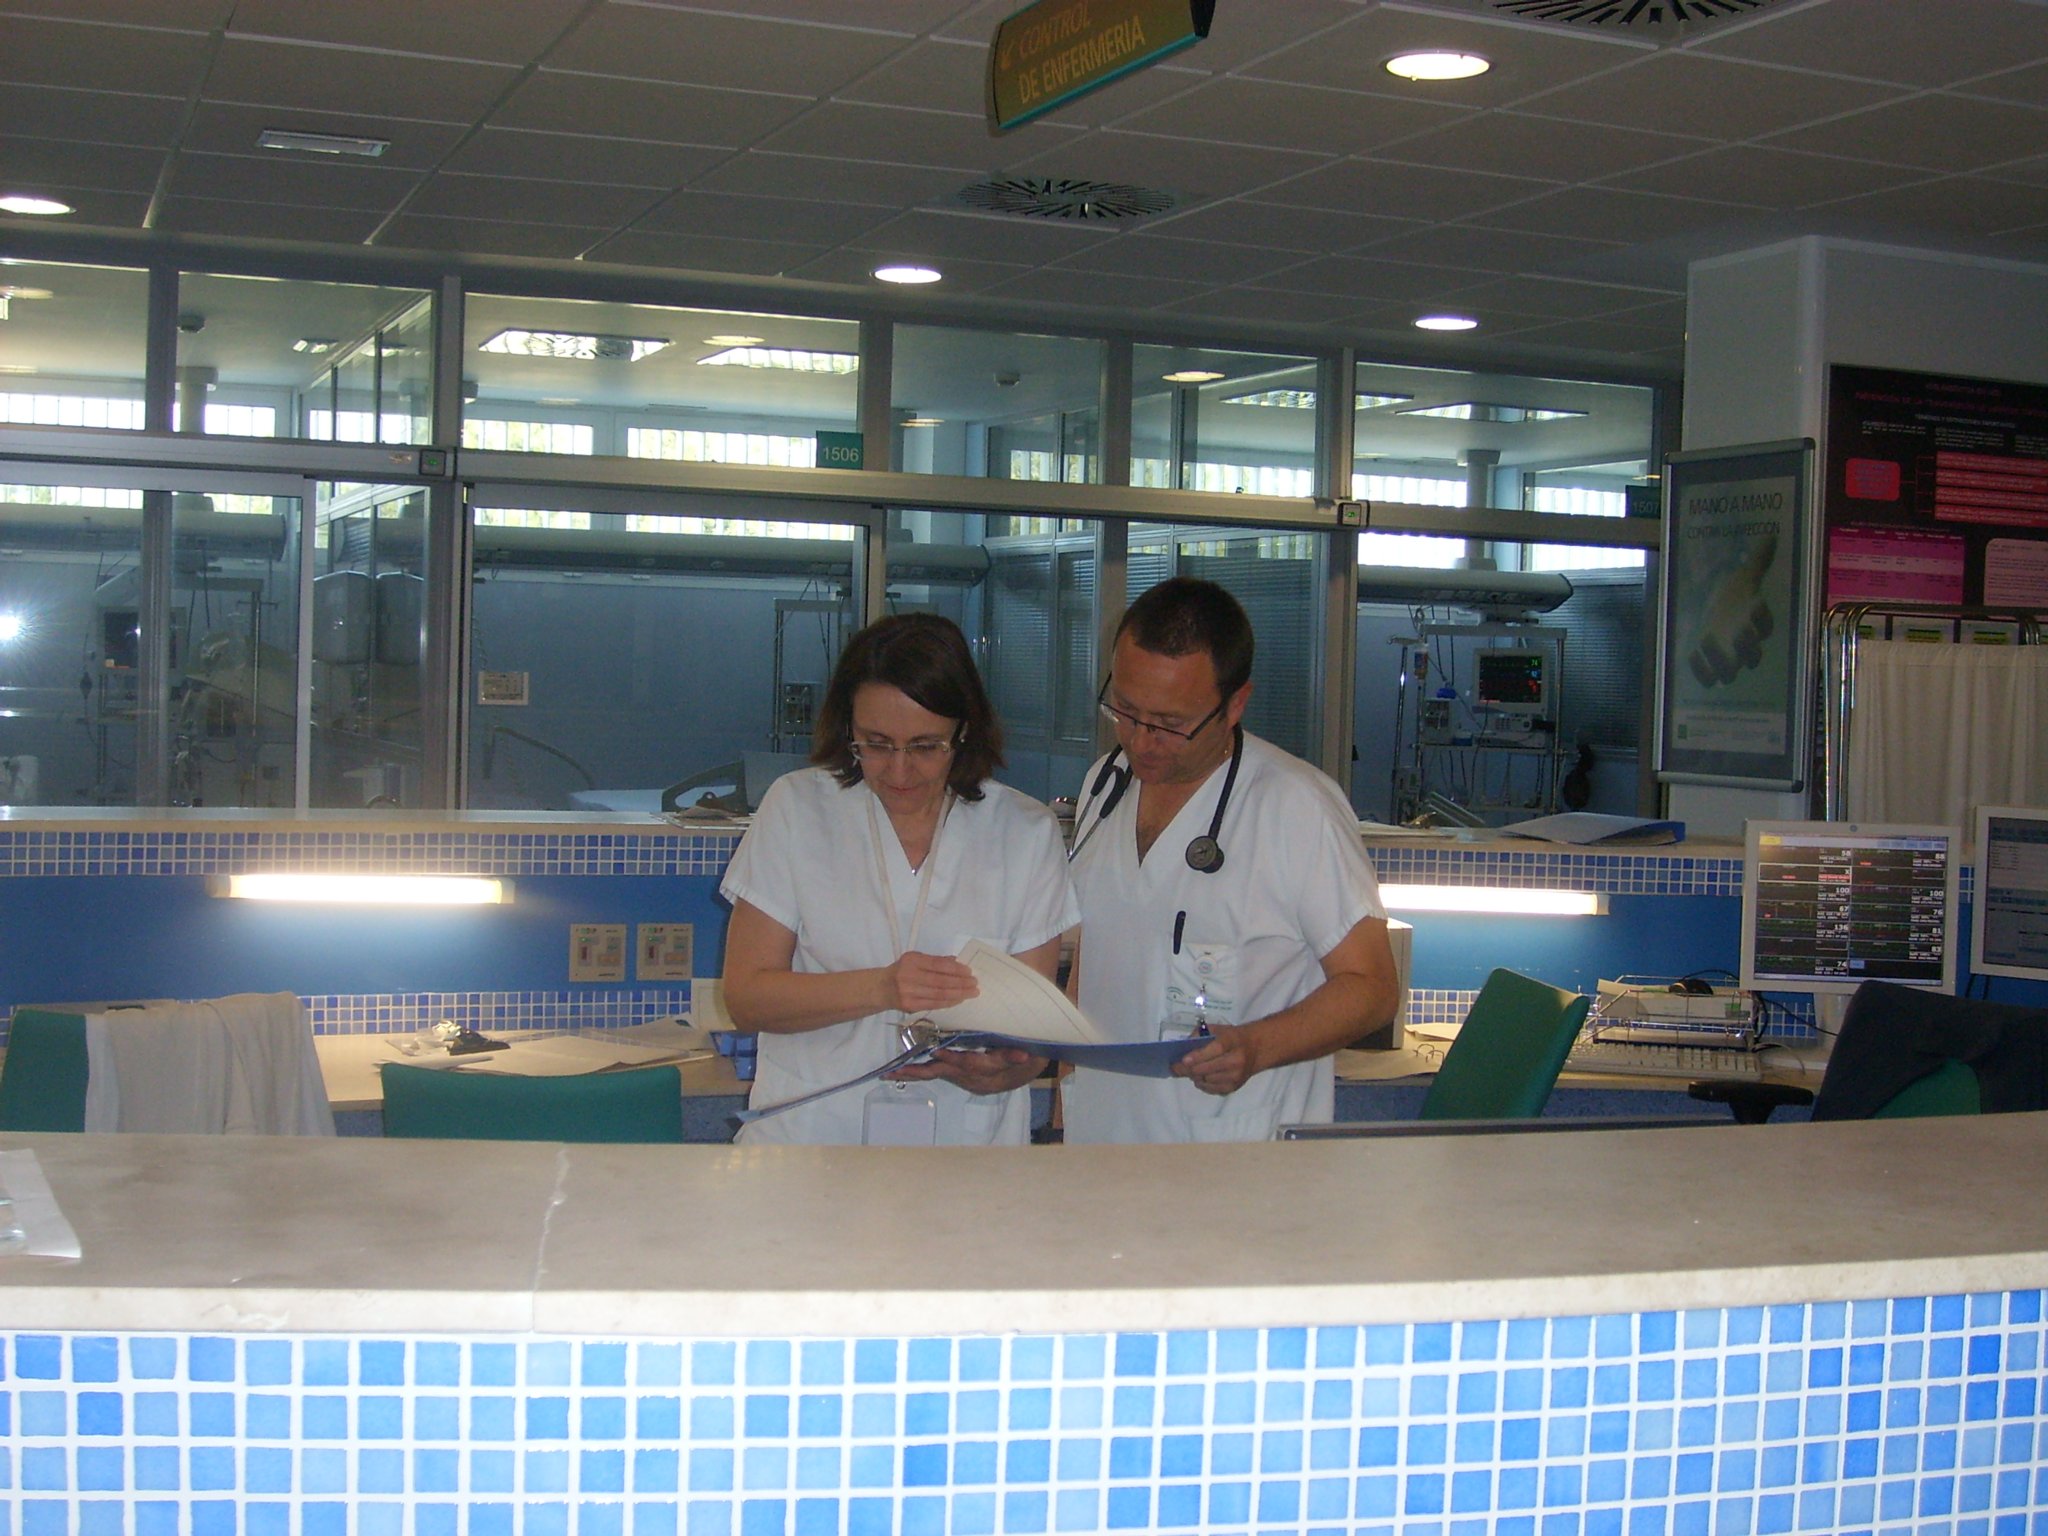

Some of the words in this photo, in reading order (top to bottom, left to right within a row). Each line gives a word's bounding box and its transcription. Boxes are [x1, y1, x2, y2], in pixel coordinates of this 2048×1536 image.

[1019, 1, 1090, 59] CONTROL
[1018, 67, 1041, 104] DE
[823, 447, 859, 462] 1506
[1688, 496, 1728, 515] MANO
[1740, 492, 1783, 513] MANO
